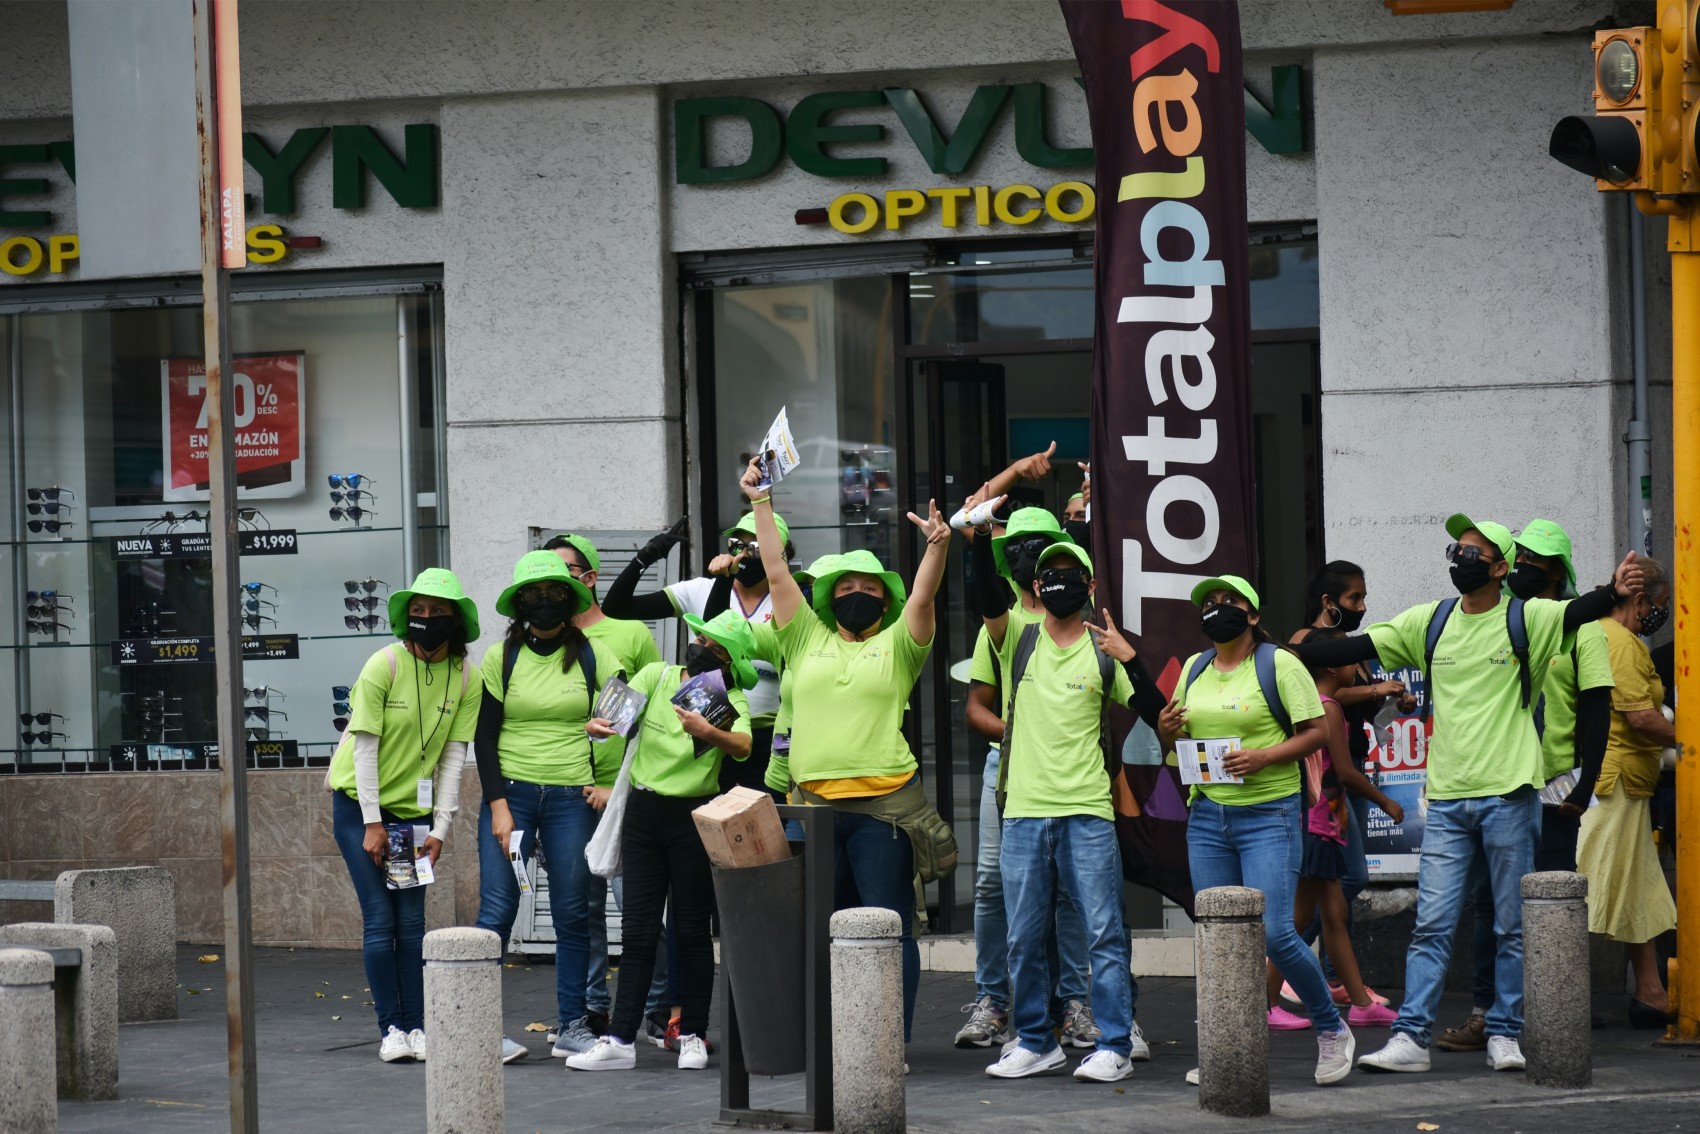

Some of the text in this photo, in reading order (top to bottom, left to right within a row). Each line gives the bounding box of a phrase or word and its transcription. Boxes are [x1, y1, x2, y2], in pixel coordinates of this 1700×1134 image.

[222, 187, 233, 251] XALAPA
[1116, 0, 1226, 637] Totalplay
[257, 406, 278, 415] DESC
[117, 539, 153, 552] NUEVA
[253, 534, 295, 550] $1,999
[159, 644, 198, 659] $1,499
[1386, 771, 1421, 783] ilimitada
[1367, 827, 1404, 838] tienes más
